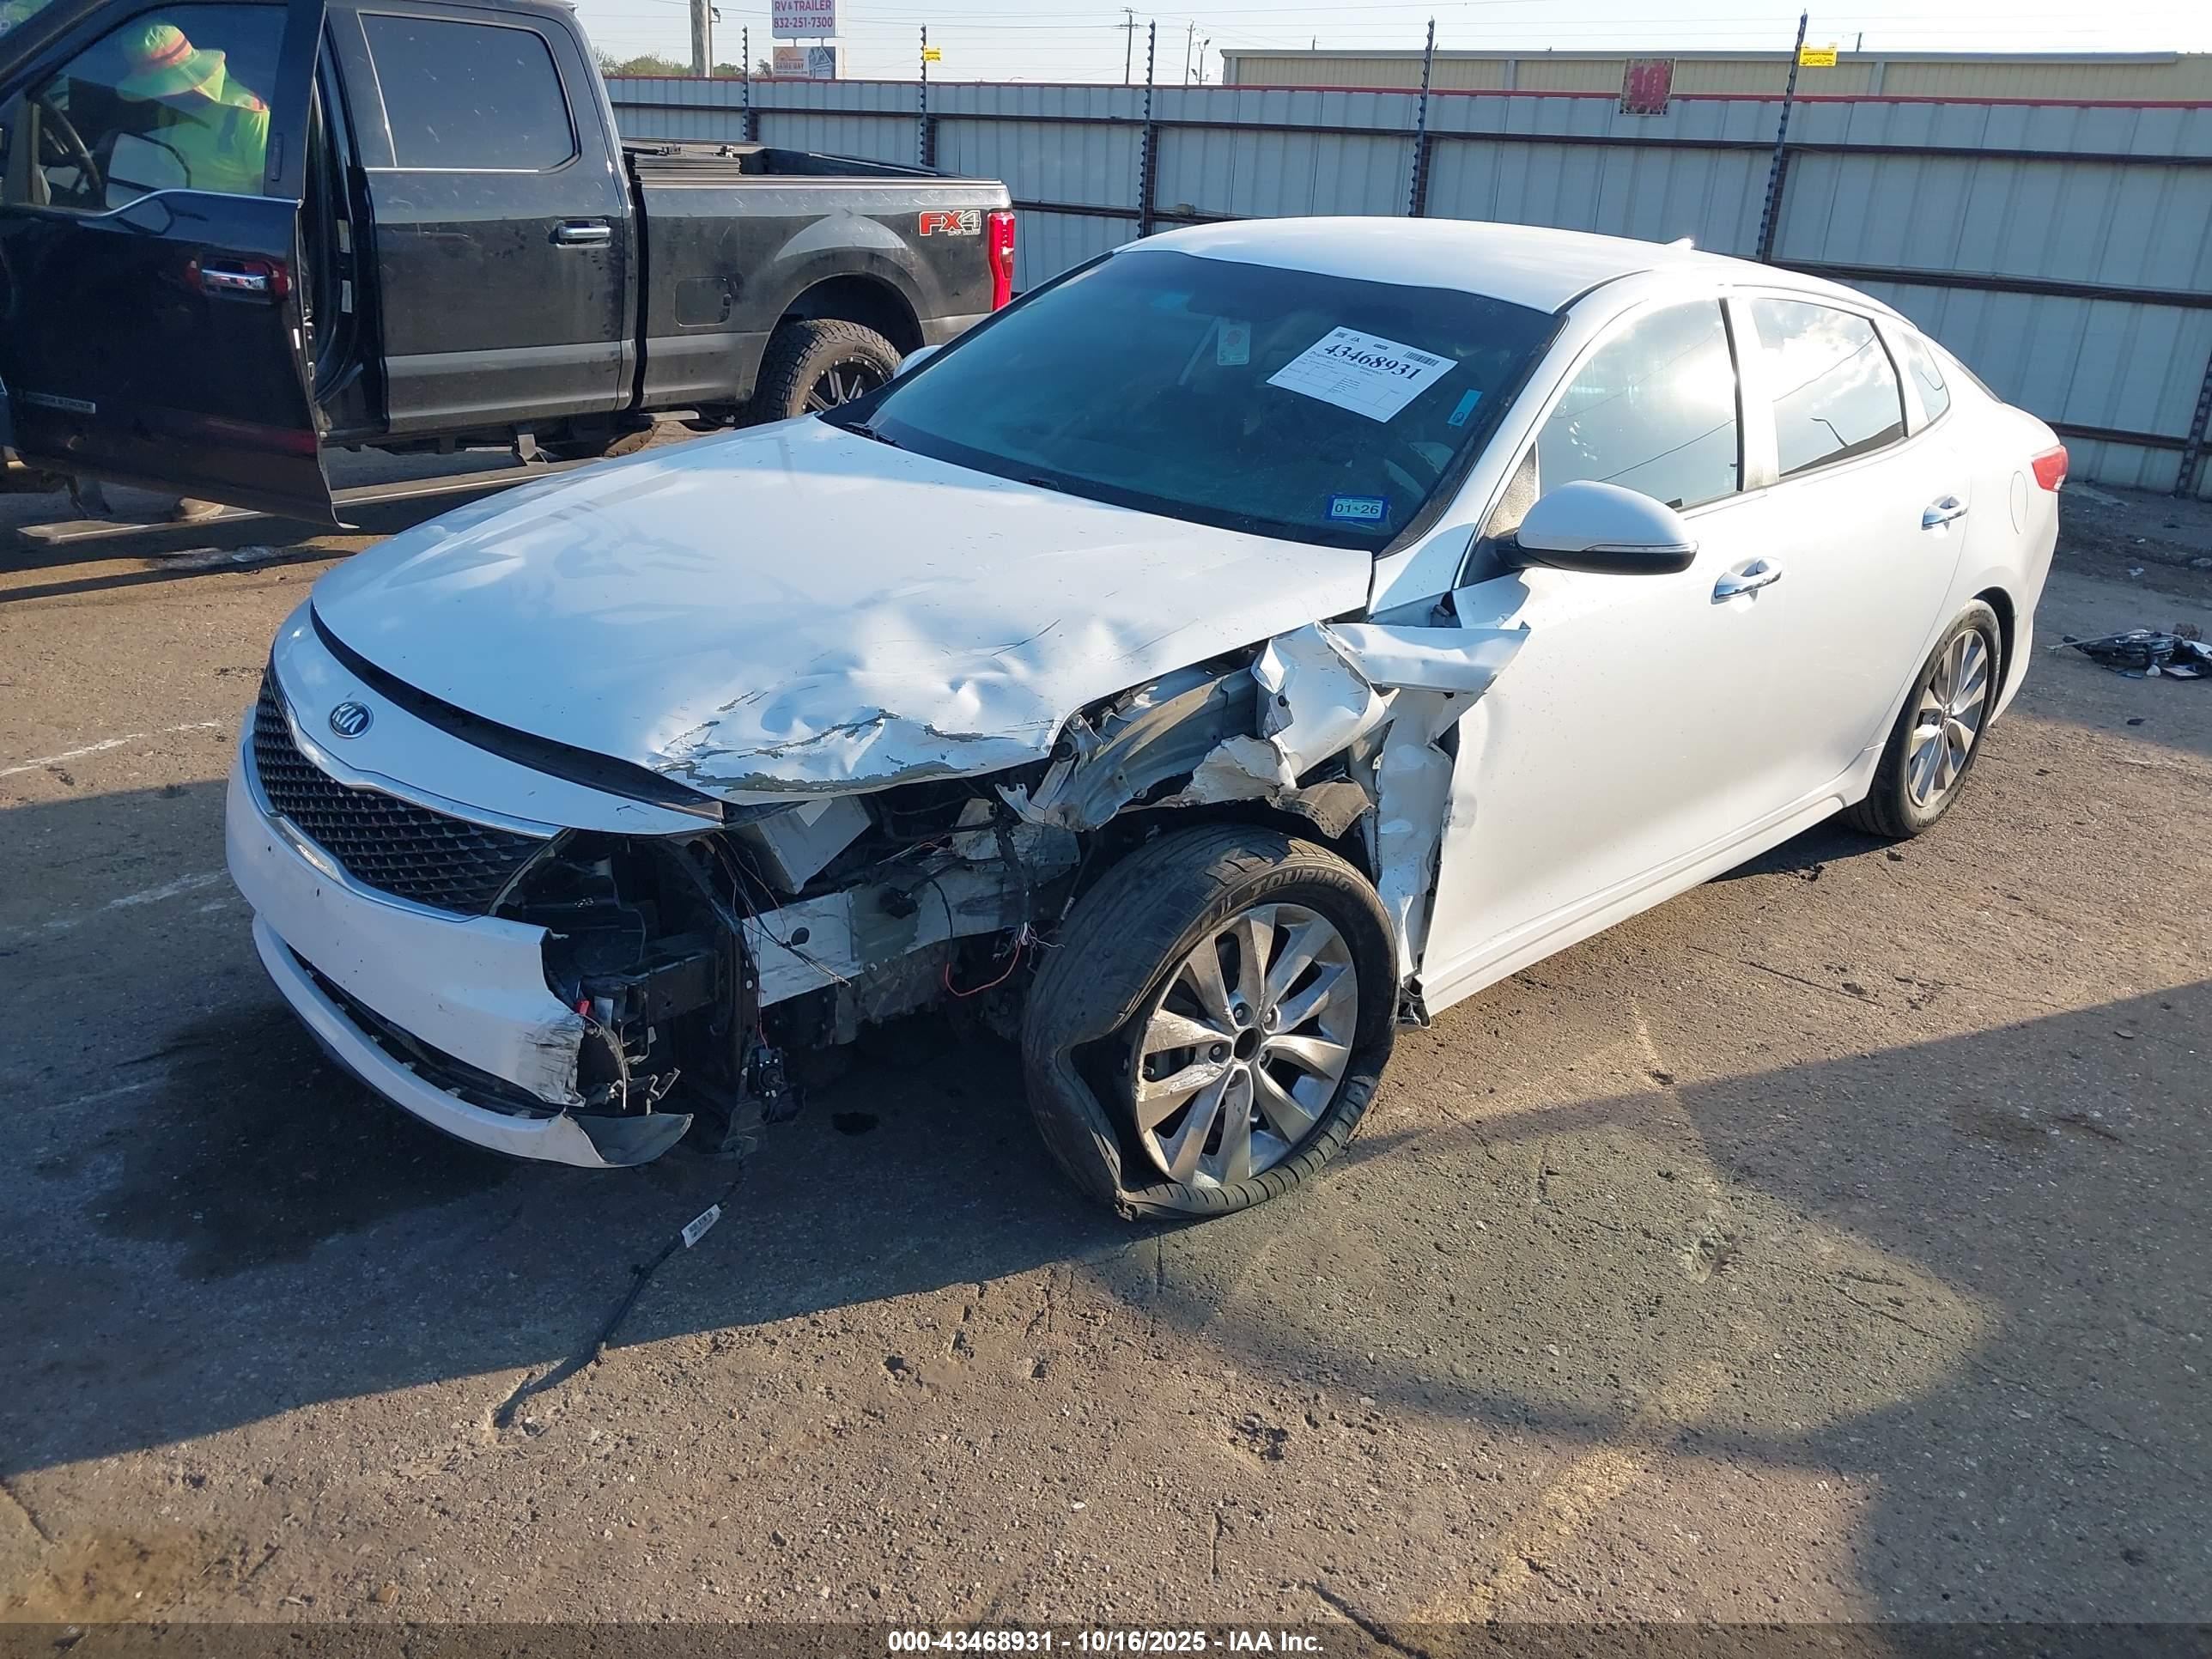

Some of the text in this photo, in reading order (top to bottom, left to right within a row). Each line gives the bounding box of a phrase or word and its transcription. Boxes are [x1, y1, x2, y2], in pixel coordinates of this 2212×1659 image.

[775, 1, 787, 11] RV
[793, 0, 831, 11] TRAILER
[774, 17, 833, 28] 832-251-7300
[919, 210, 981, 236] FX4
[1324, 343, 1422, 380] 43468931
[331, 703, 364, 734] KIA
[1250, 868, 1352, 896] TOURING
